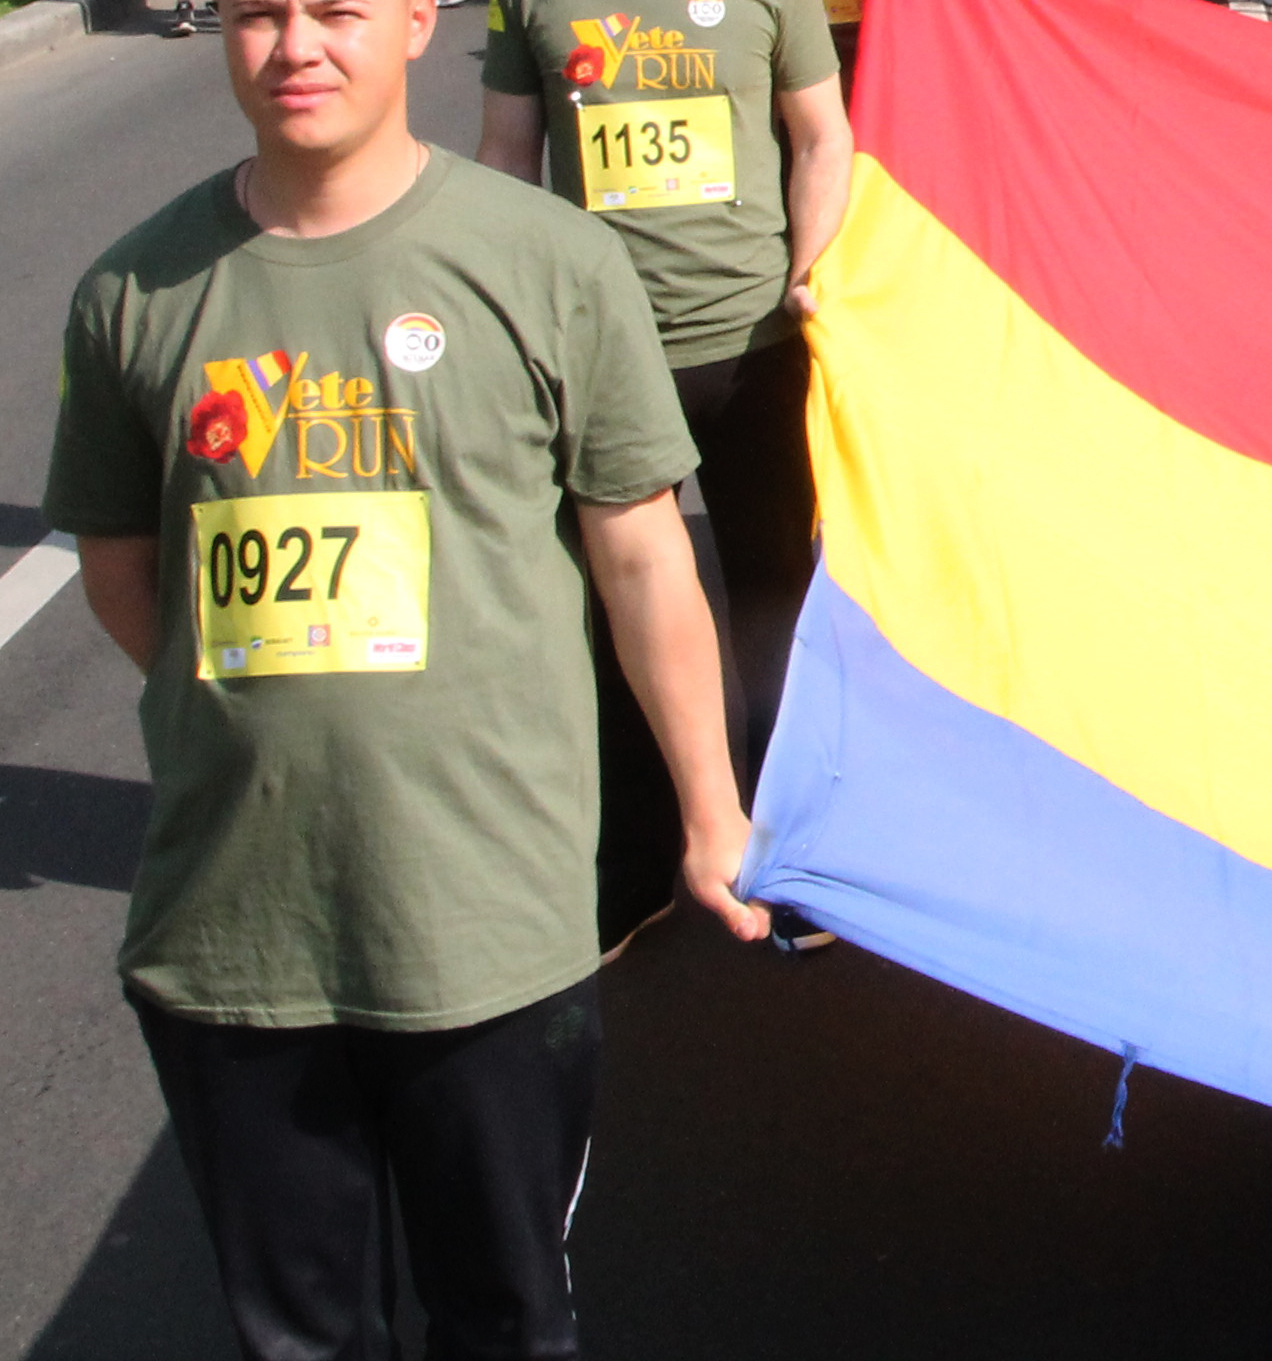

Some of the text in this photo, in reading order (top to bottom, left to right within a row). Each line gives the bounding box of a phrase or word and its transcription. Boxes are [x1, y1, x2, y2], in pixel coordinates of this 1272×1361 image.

[634, 54, 716, 90] RUN
[592, 119, 692, 170] 1135
[296, 415, 416, 479] RUN
[209, 525, 361, 609] 0927
